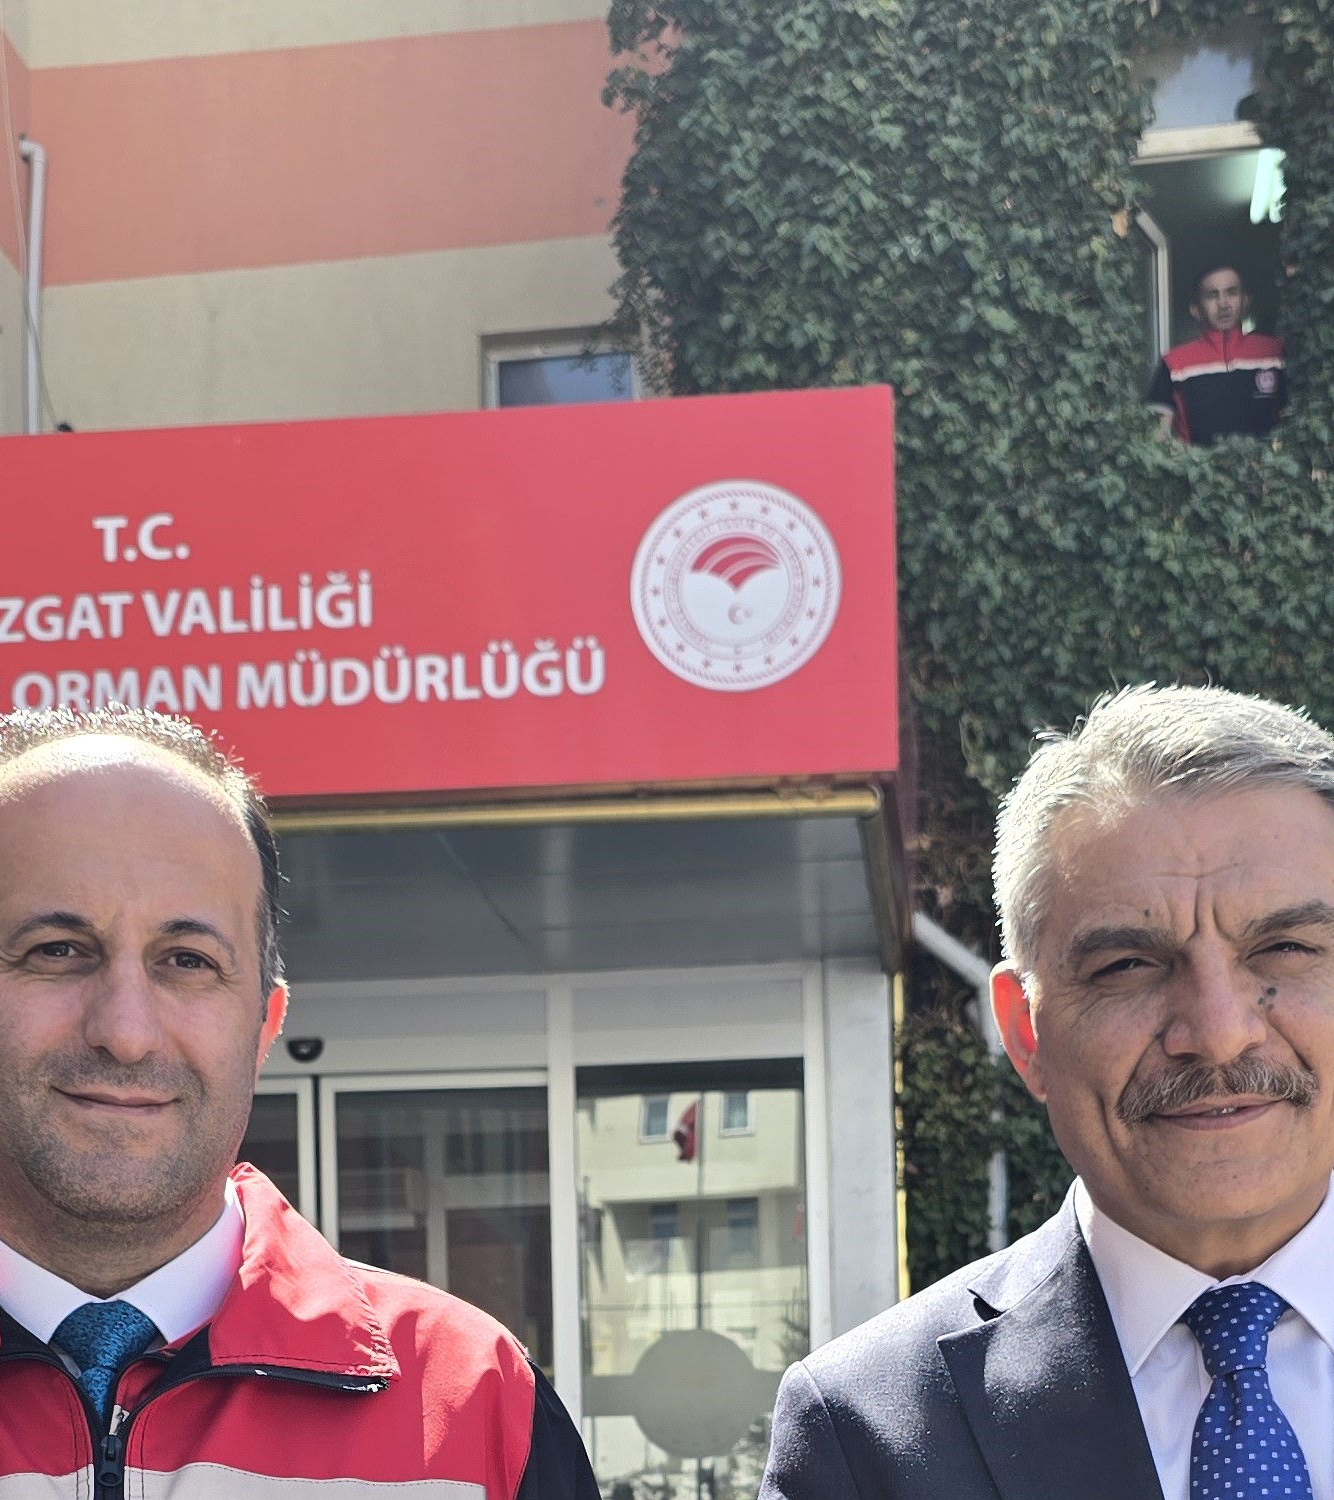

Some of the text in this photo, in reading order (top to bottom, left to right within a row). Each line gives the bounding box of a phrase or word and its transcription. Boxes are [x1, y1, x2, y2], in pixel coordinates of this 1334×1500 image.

[92, 513, 191, 563] T.C.
[141, 568, 374, 638] VALİLİĞİ
[12, 662, 224, 716] ORMAN
[236, 634, 605, 710] MÜDÜRLÜĞÜ
